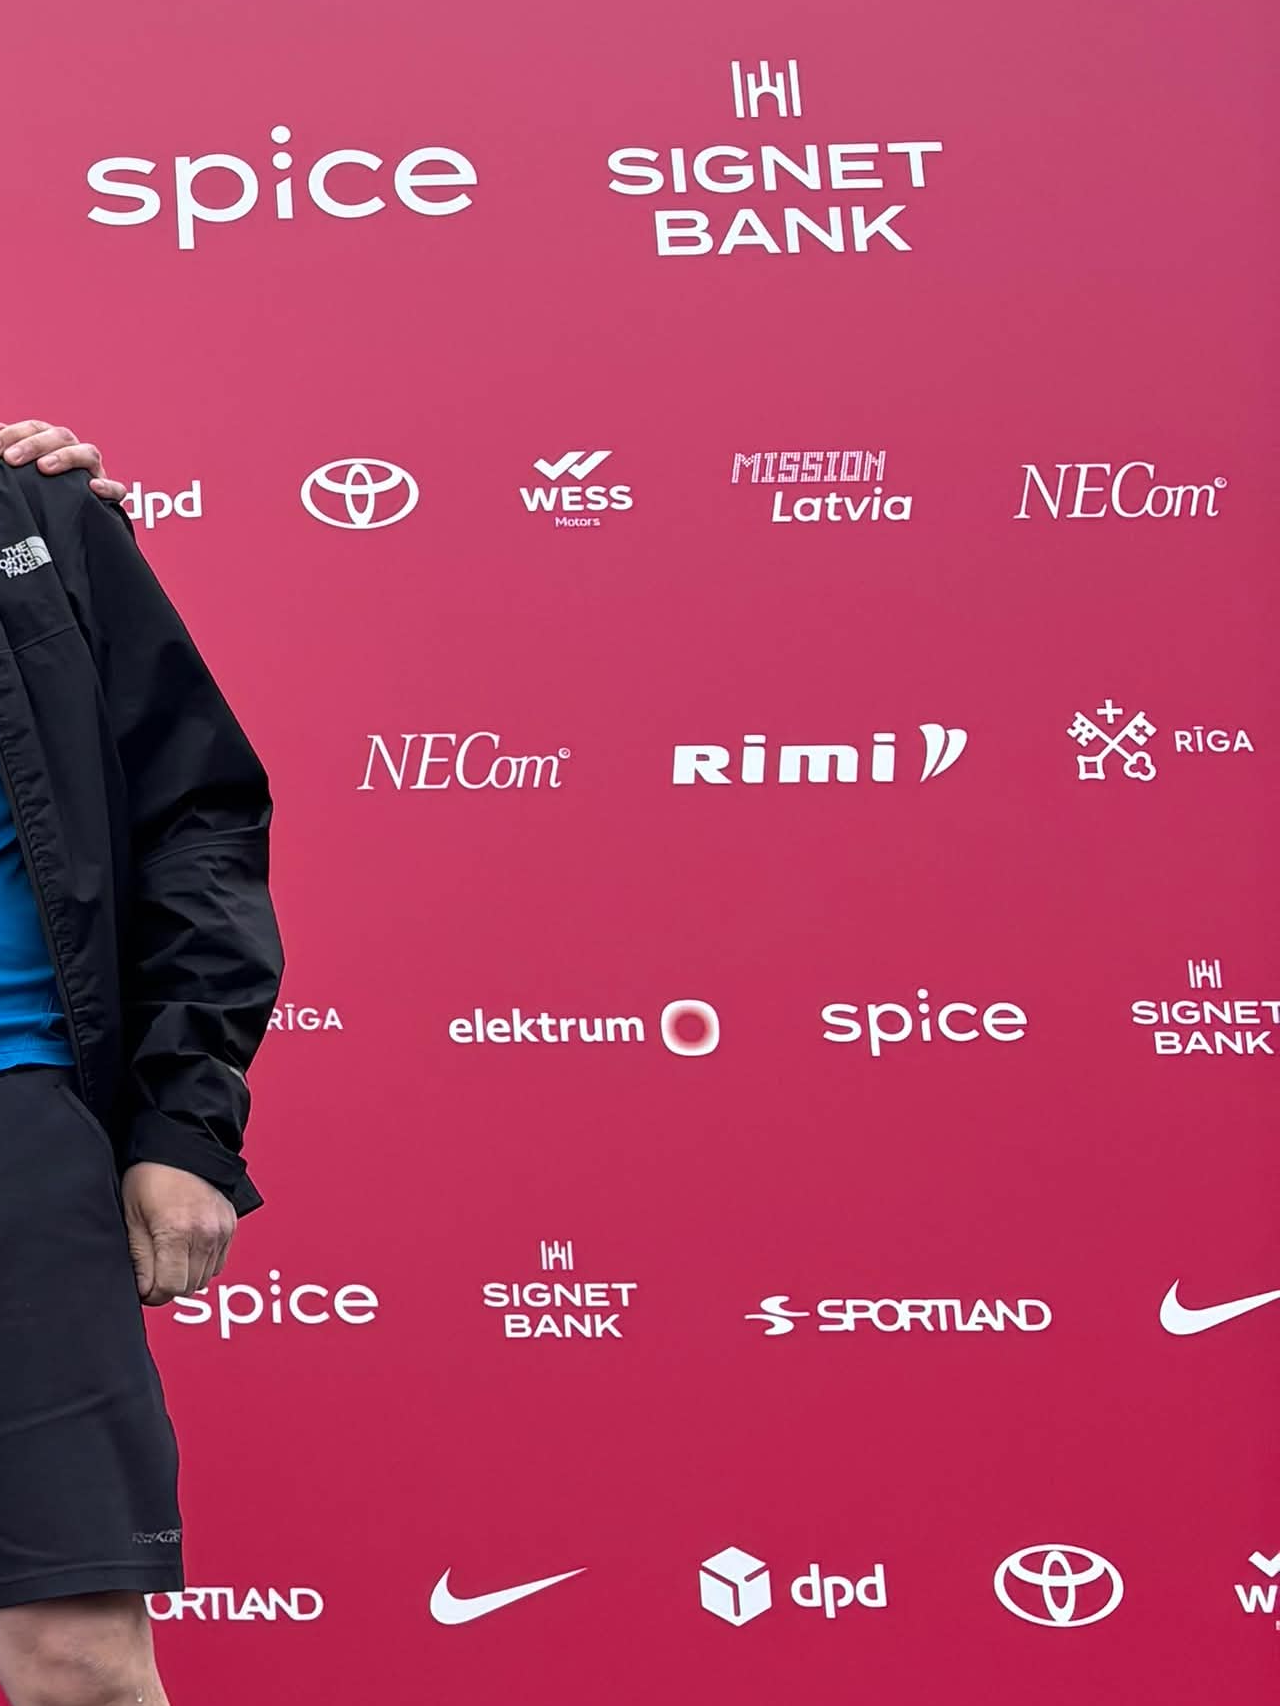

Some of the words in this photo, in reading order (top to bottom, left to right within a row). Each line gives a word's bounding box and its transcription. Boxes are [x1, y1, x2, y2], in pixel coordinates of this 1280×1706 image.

[608, 142, 942, 194] SIGNET
[88, 126, 477, 249] spice
[655, 205, 911, 255] BANK
[732, 451, 885, 483] MISSION
[120, 480, 202, 529] dpd
[520, 486, 632, 511] WESS
[773, 487, 912, 521] Latvia
[555, 516, 601, 527] Motors
[2, 541, 27, 558] THE
[6, 559, 38, 578] FACE
[1175, 726, 1253, 751] RĪGA
[673, 733, 895, 784] Rimi
[449, 1009, 644, 1043] elektrum
[822, 989, 1027, 1056] spice
[1132, 1001, 1280, 1024] SIGNET
[1155, 1032, 1273, 1054] BANK
[172, 1270, 379, 1339] spice
[484, 1283, 637, 1307] SIGNET
[505, 1314, 622, 1337] BANK
[818, 1299, 1051, 1331] SPORTLAND
[144, 1587, 323, 1620] ORTLAND
[791, 1564, 886, 1618] dpd
